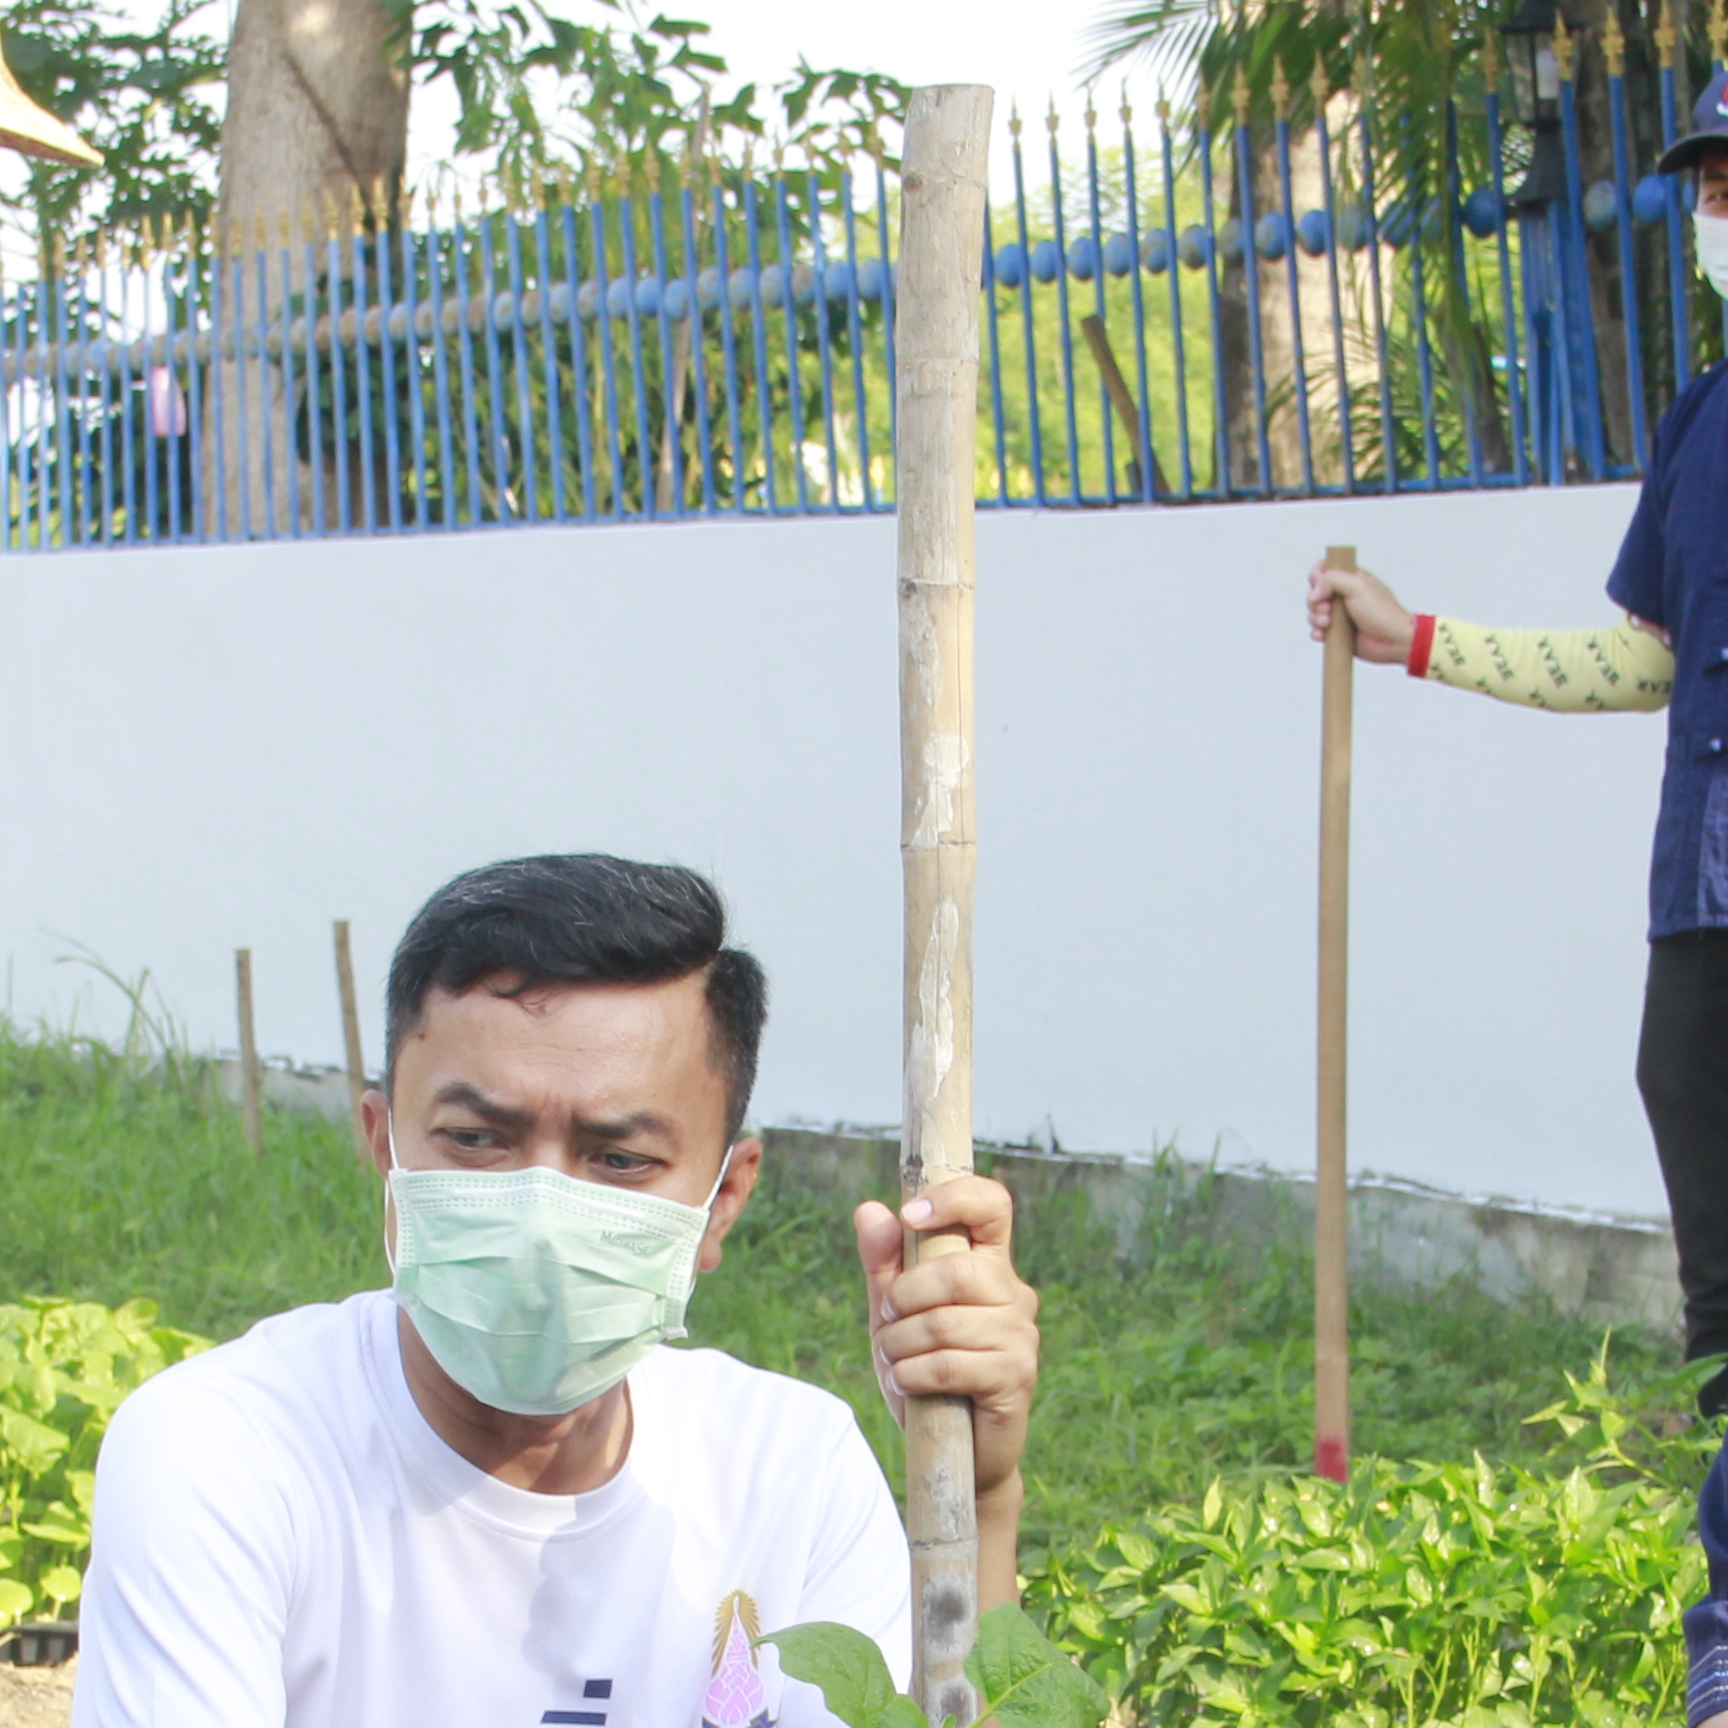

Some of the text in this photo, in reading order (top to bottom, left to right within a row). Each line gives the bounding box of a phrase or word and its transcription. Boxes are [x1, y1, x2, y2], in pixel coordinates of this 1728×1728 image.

[1484, 635, 1514, 681] BEAR
[1537, 636, 1568, 688] BEAR
[1587, 635, 1620, 686] BEAR
